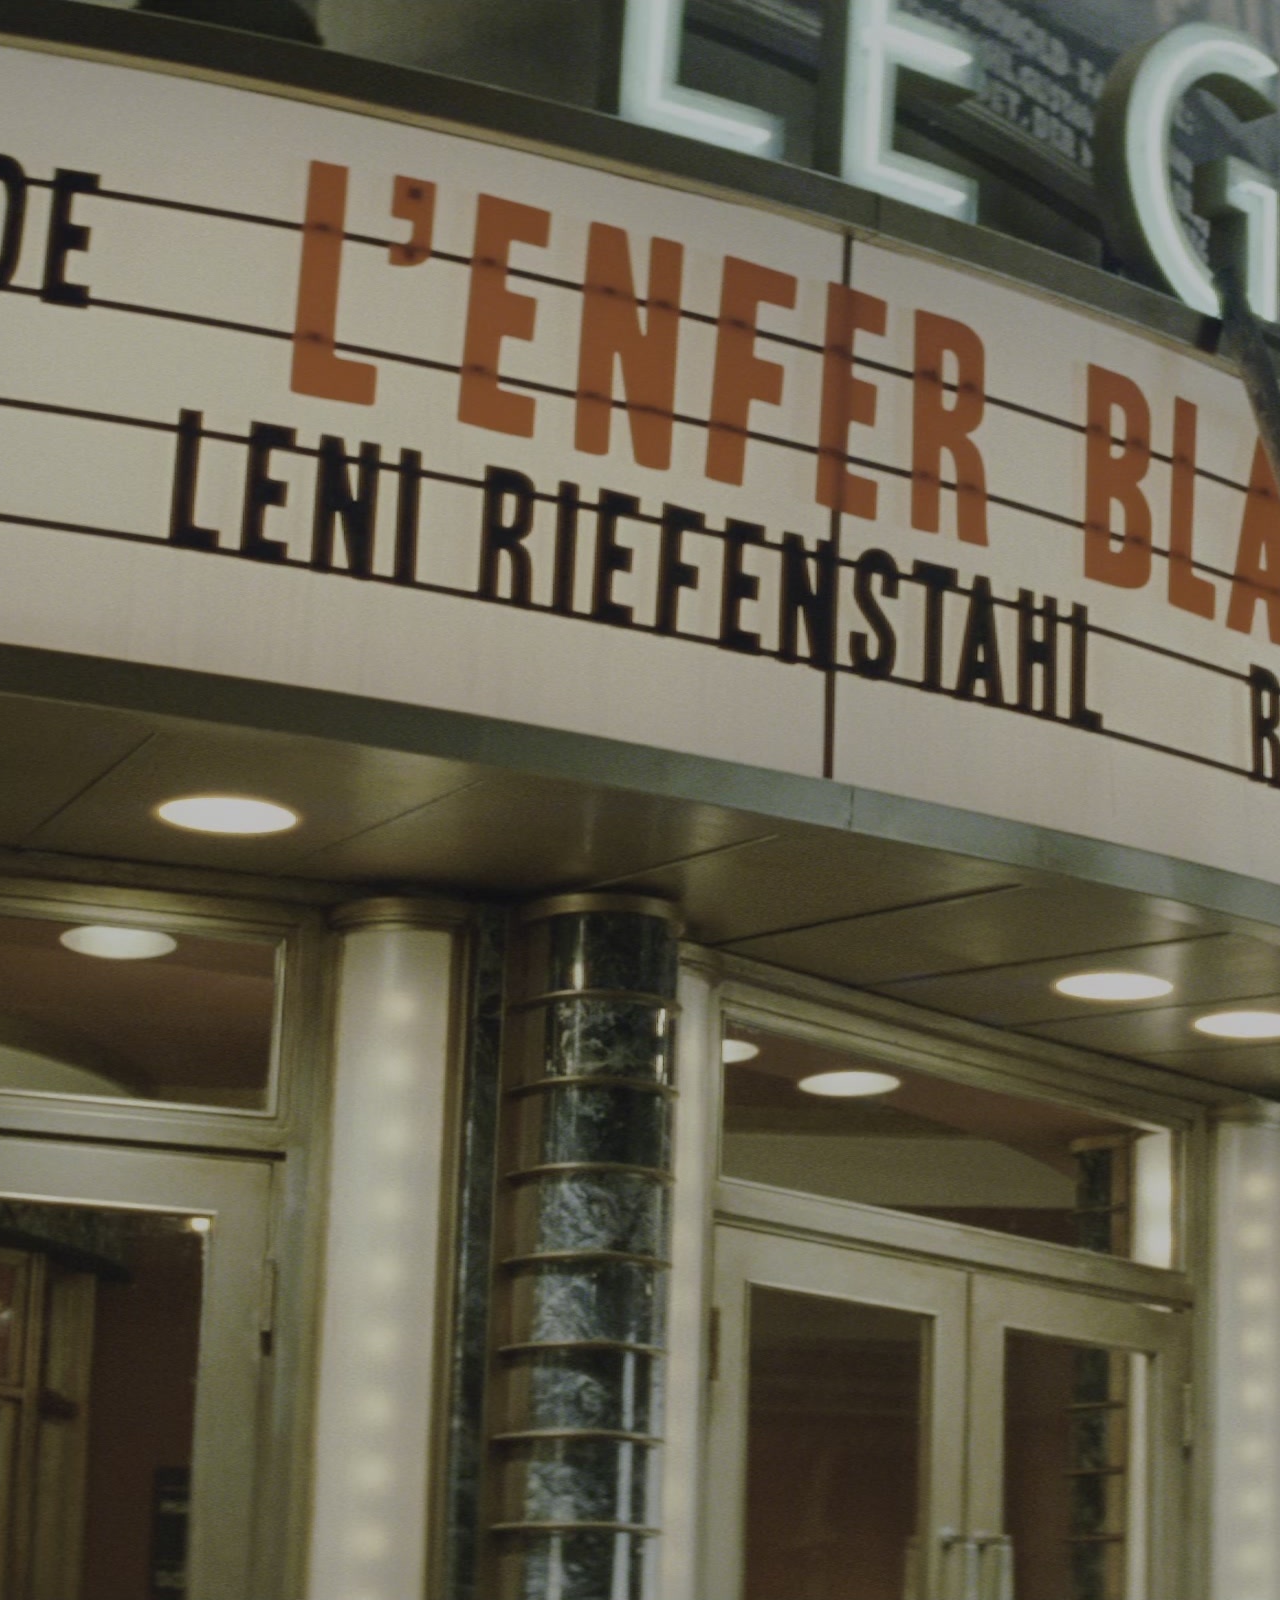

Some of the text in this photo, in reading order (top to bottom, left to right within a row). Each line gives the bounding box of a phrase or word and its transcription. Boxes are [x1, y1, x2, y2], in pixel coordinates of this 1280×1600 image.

[617, 0, 978, 226] LE
[290, 159, 989, 548] L'ENFER
[169, 408, 1103, 731] LENI RIEFENSTAHL
